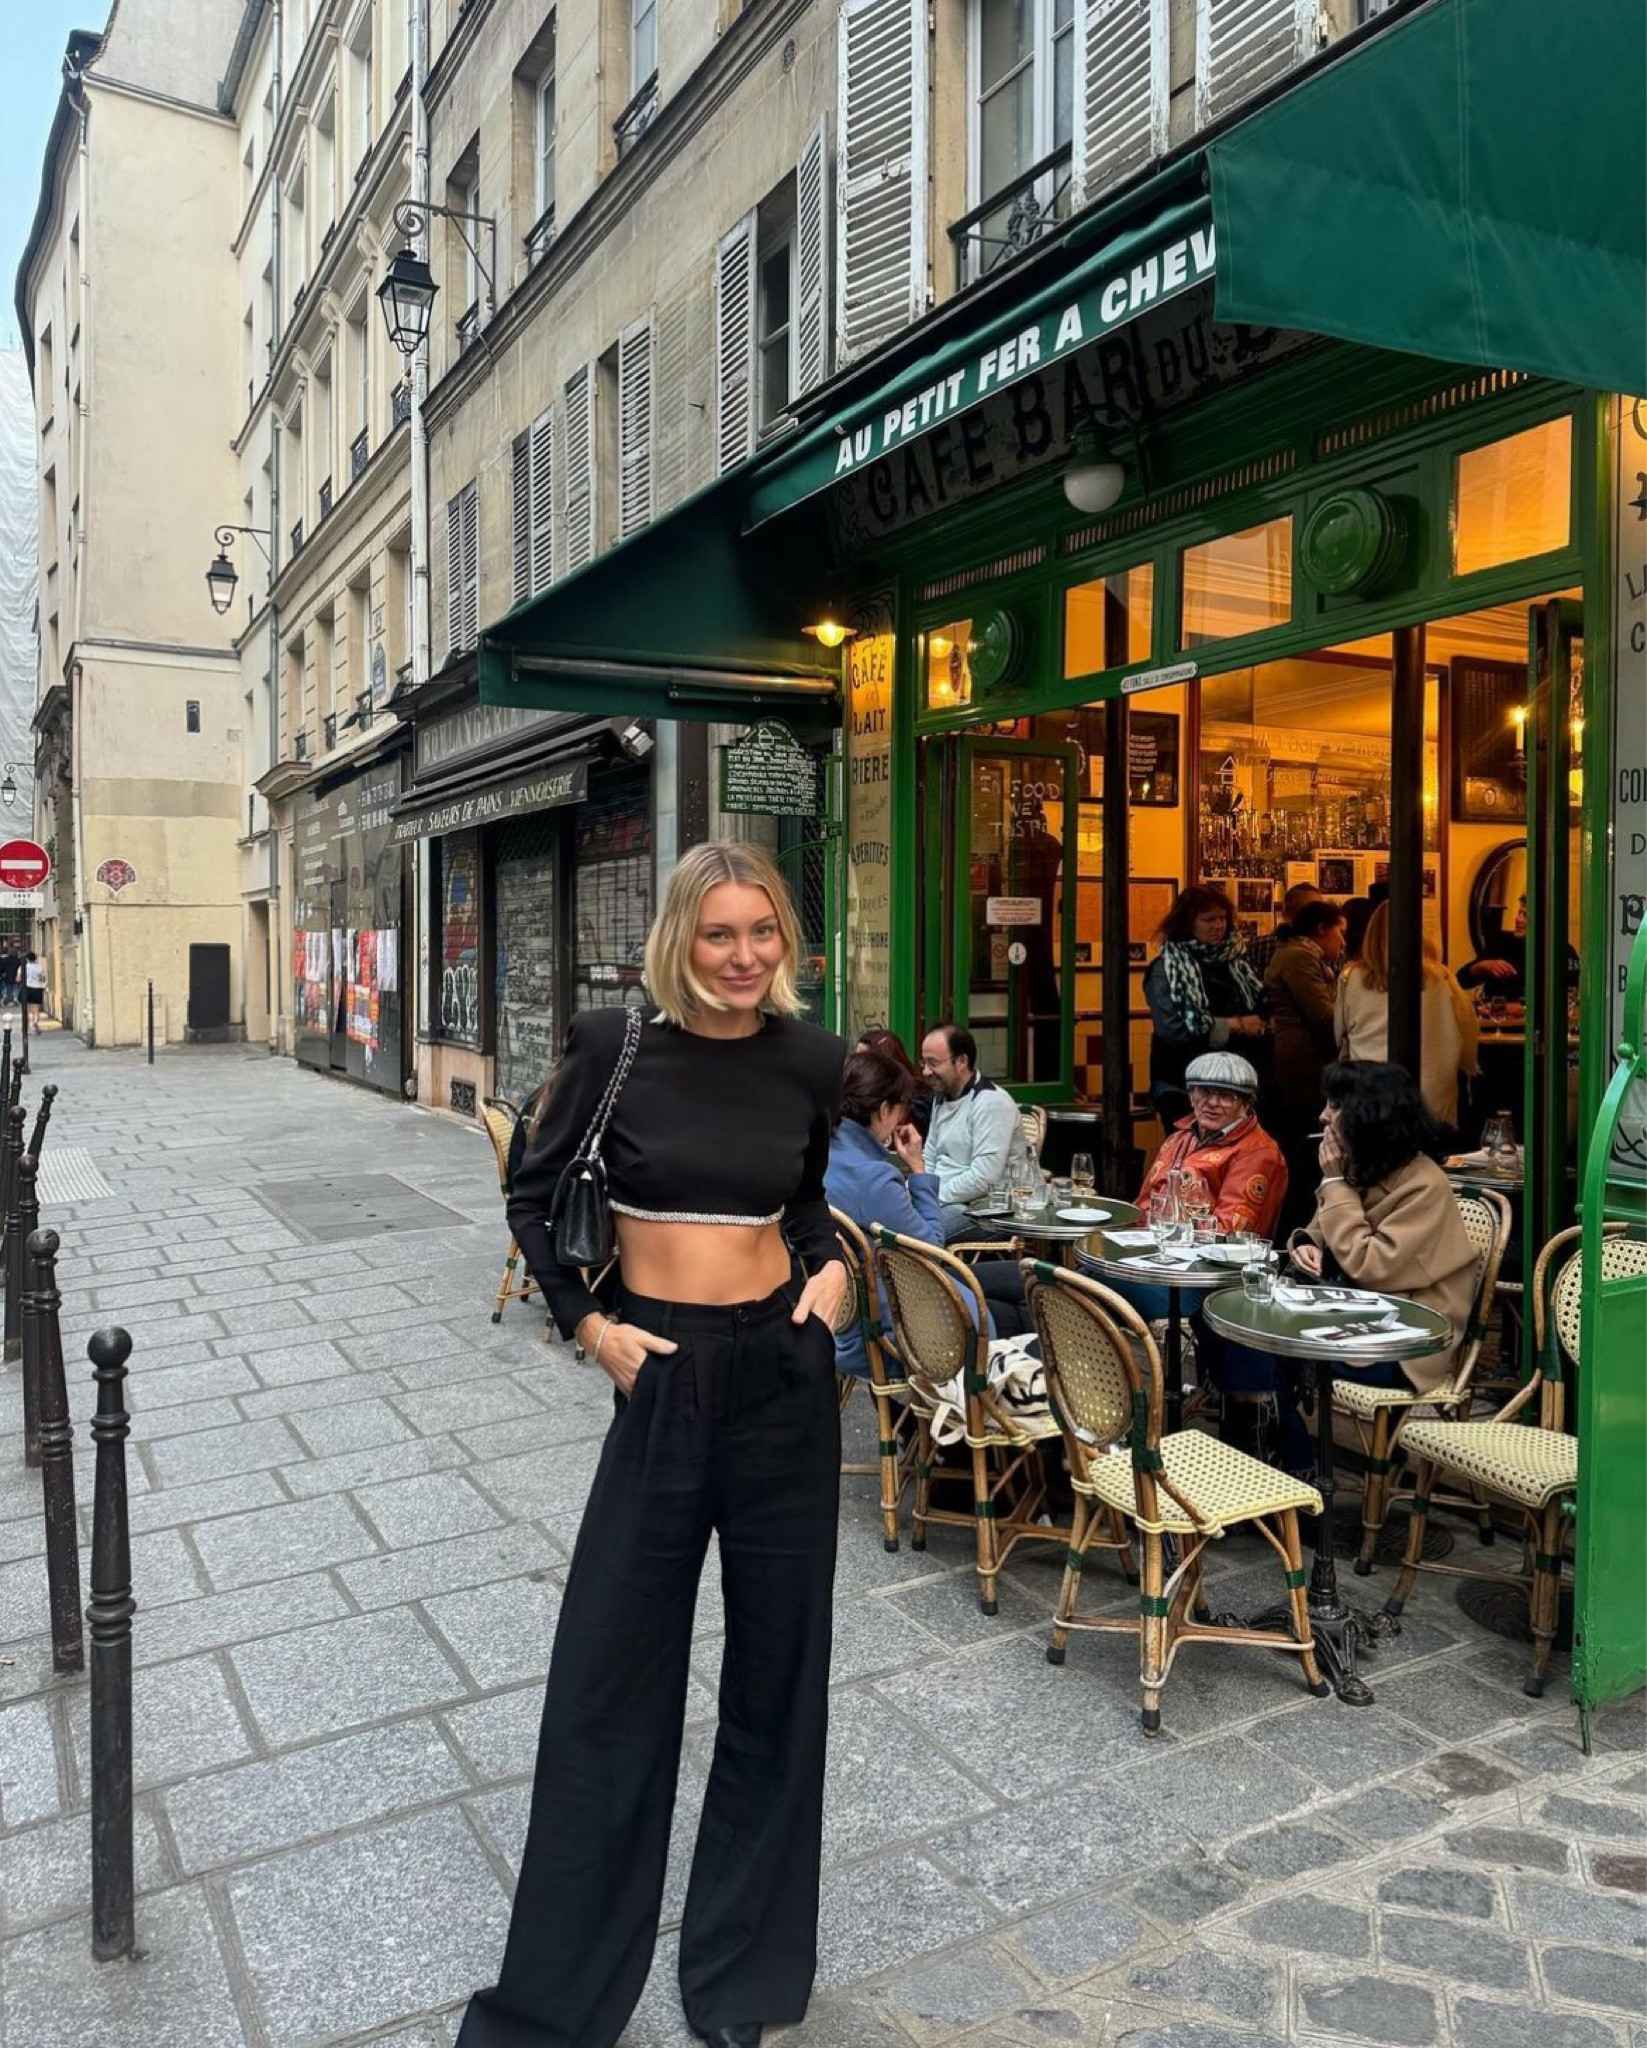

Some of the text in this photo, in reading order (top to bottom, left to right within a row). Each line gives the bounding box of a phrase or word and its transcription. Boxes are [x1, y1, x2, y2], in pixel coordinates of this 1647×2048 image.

[834, 223, 1216, 475] AU PETIT FER A CHEV
[853, 708, 886, 736] LAIT
[852, 752, 889, 785] BIÈRE
[1011, 779, 1061, 799] FOOD
